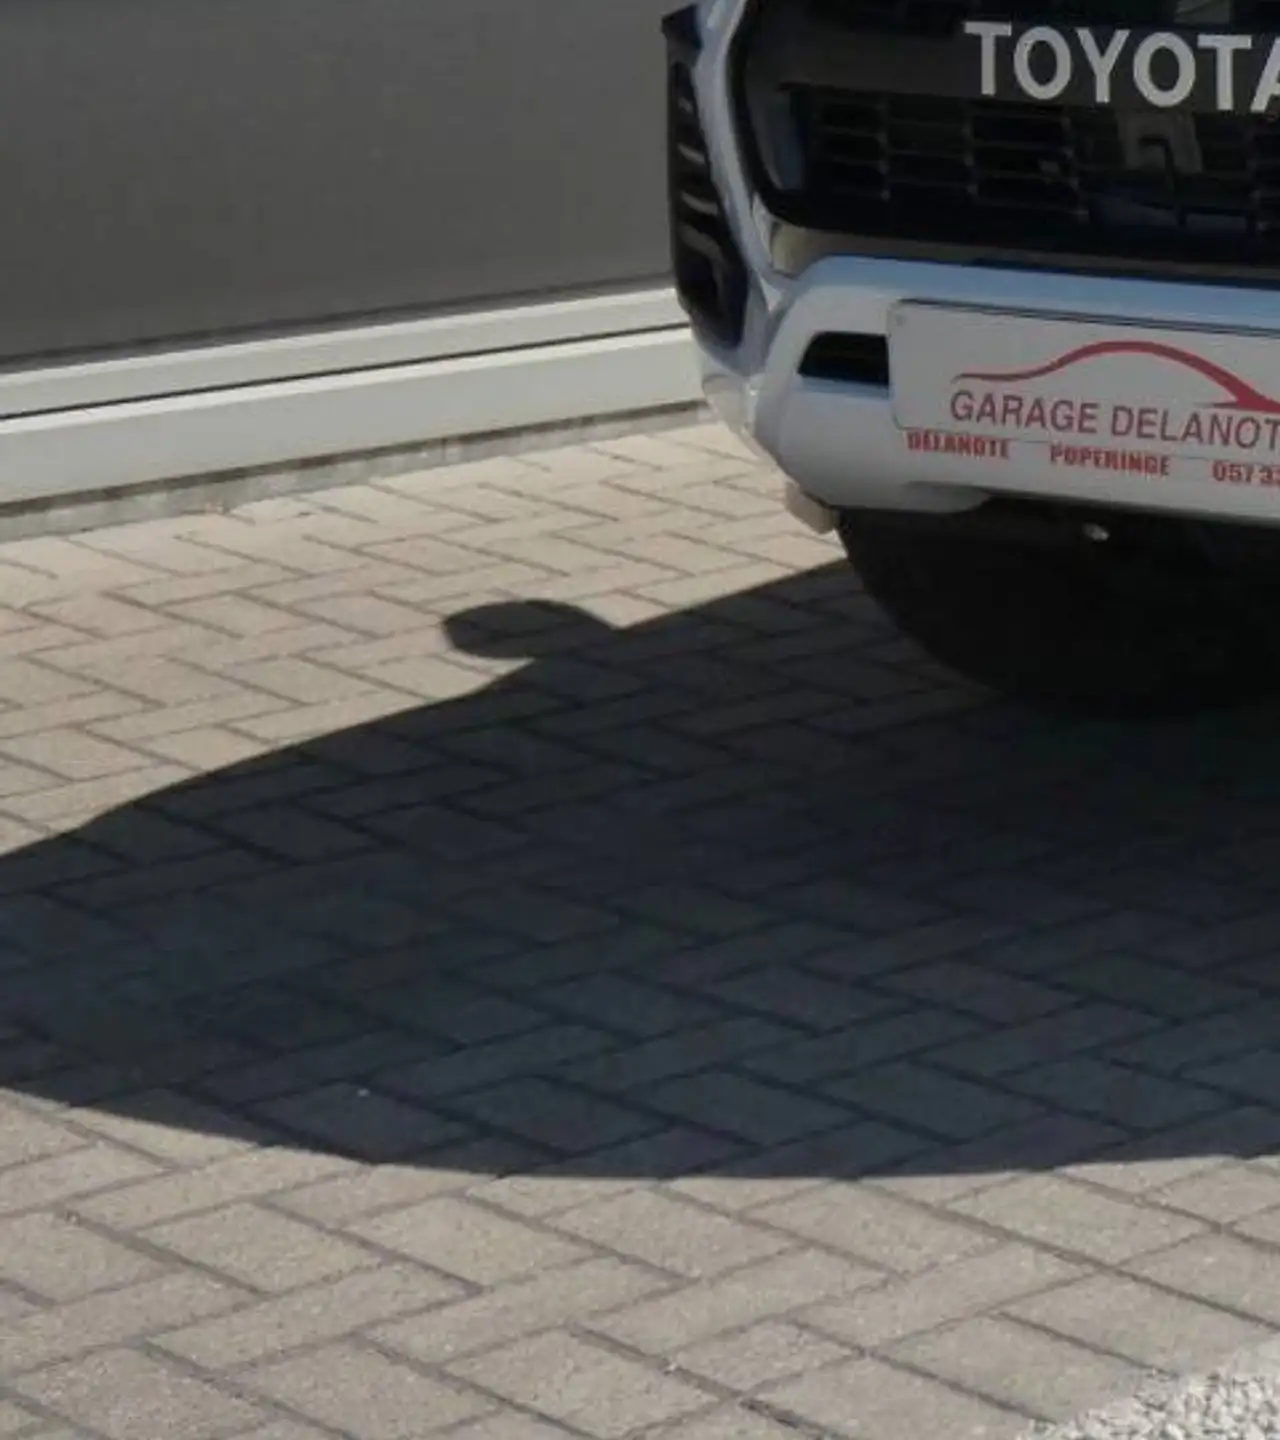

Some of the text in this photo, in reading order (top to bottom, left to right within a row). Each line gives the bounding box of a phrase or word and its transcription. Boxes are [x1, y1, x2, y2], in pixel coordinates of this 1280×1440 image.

[950, 390, 1098, 434] GARAGE
[907, 429, 1010, 459] DELANOTE
[1050, 442, 1170, 476] POPERINGE
